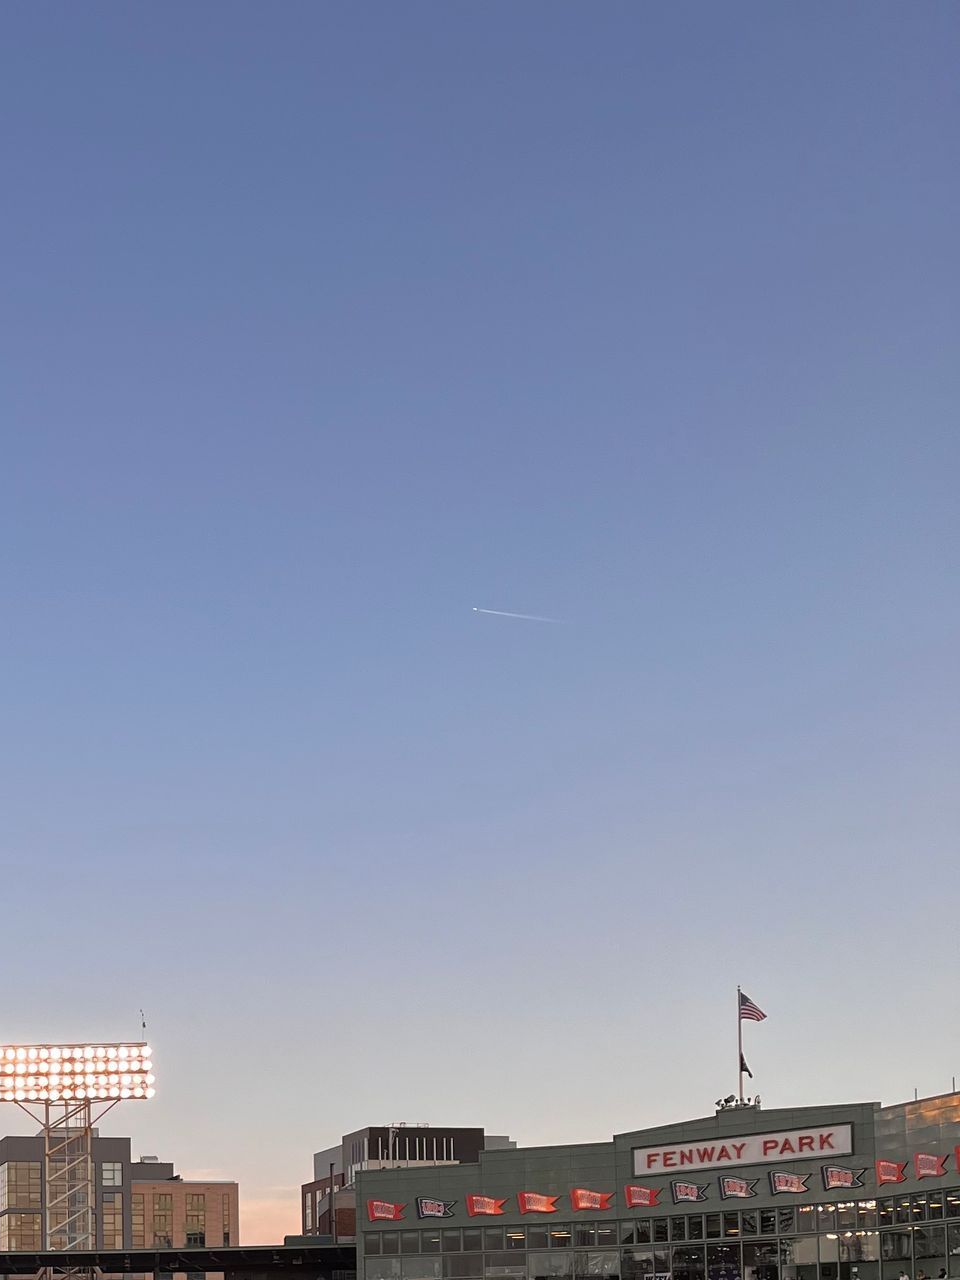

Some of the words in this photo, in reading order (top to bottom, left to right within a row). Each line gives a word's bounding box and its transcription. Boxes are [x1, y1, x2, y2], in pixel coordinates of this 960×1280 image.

[647, 1143, 746, 1169] FENWAY
[762, 1132, 835, 1156] PARK
[775, 1175, 800, 1188] 1975
